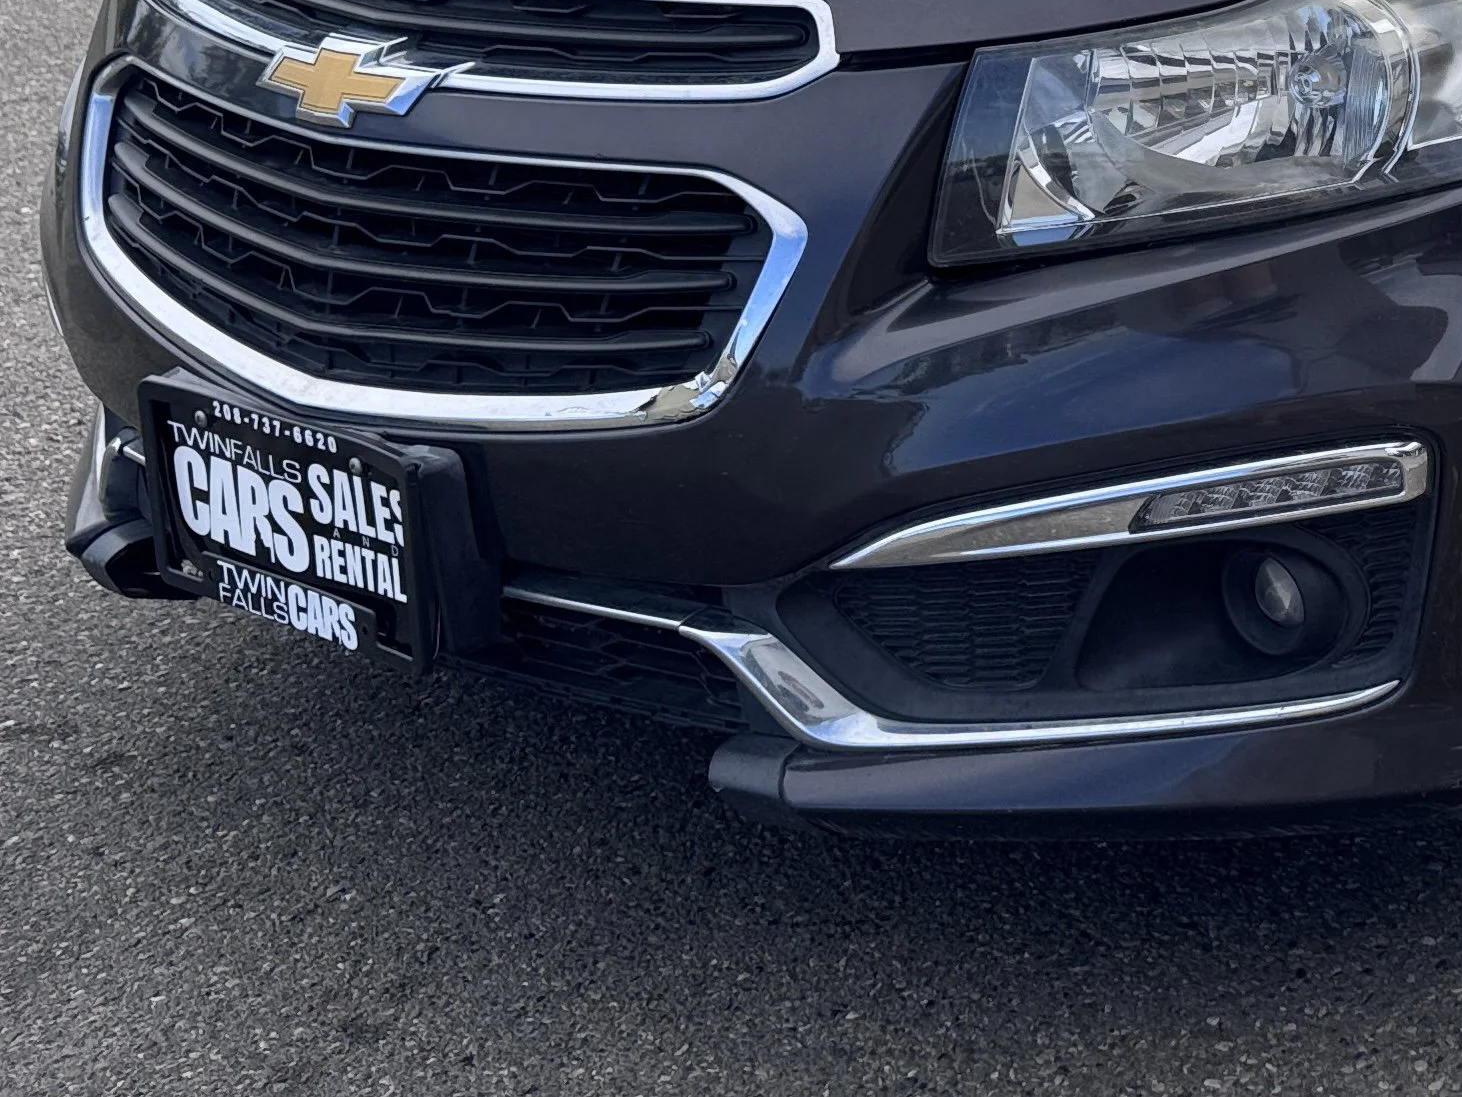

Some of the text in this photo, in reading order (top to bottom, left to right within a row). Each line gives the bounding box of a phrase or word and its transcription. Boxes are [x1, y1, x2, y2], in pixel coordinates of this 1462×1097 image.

[167, 420, 302, 484] TWINFALLS
[213, 401, 338, 454] 208-737-6620
[173, 446, 405, 573] CARS SALES
[217, 560, 287, 604] TWIN
[219, 582, 359, 651] FALLS CARS
